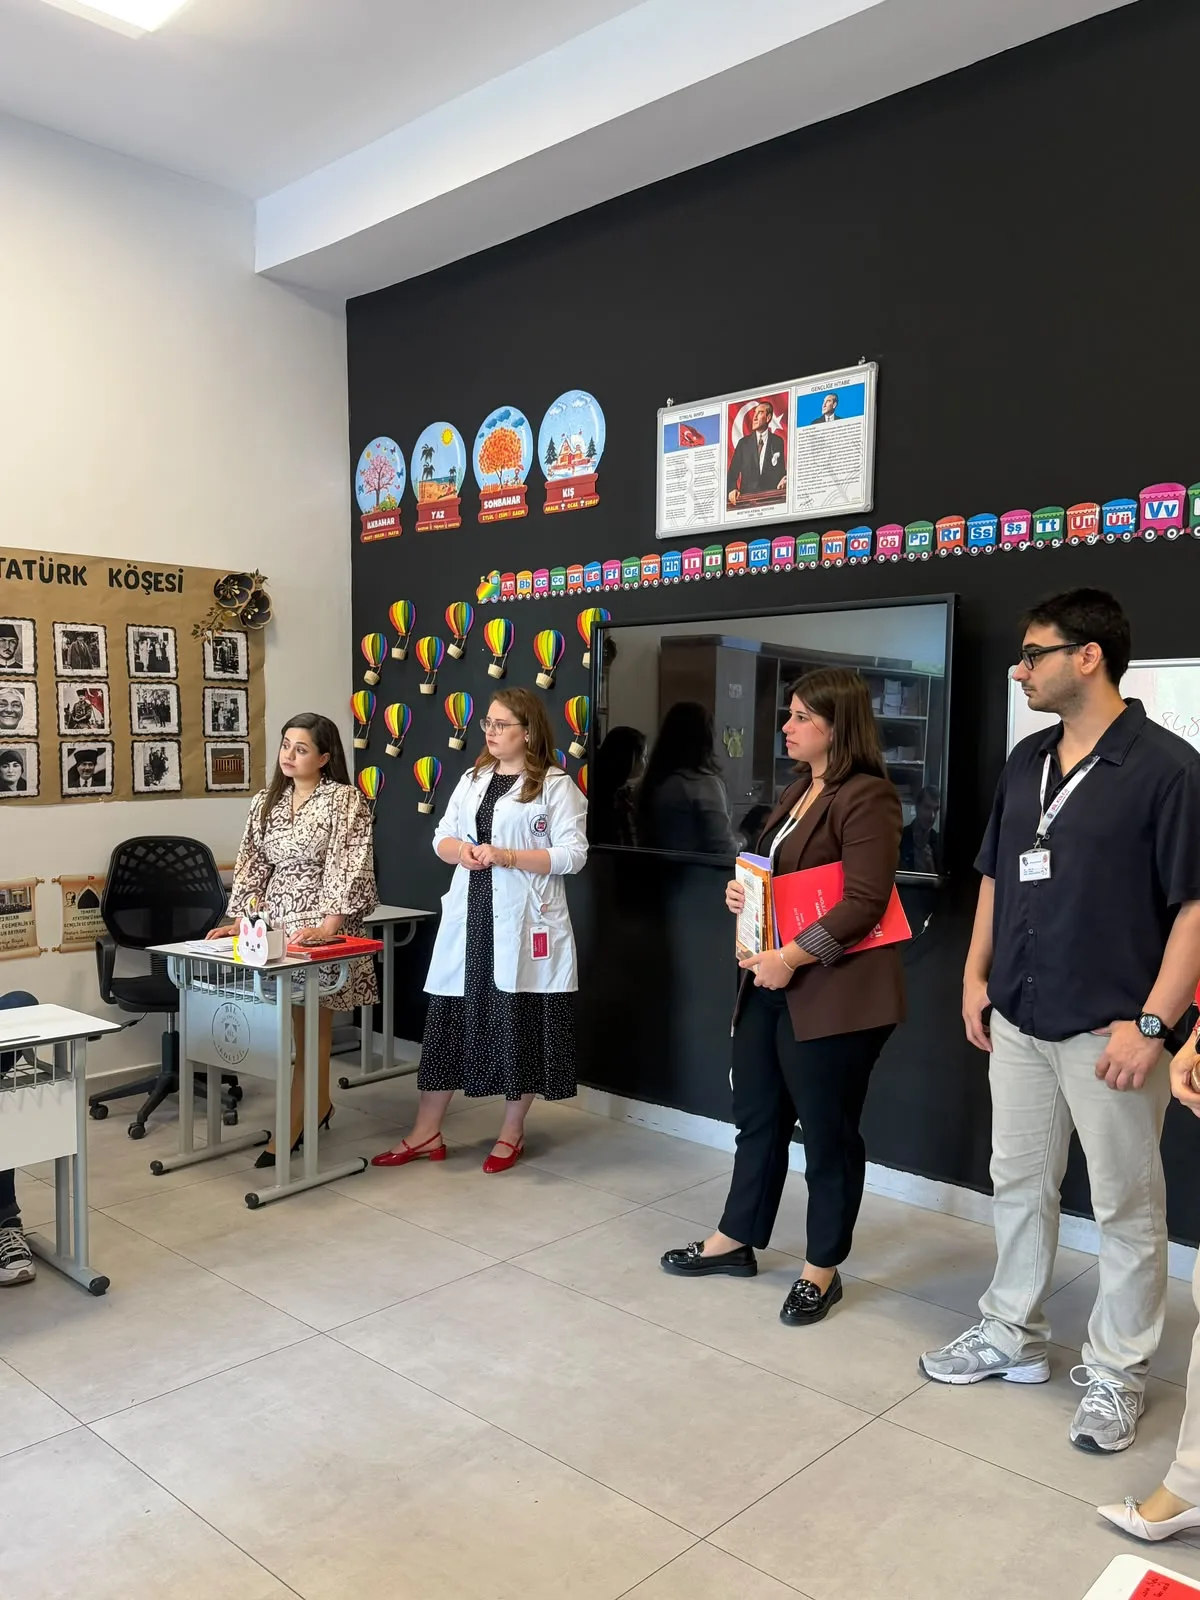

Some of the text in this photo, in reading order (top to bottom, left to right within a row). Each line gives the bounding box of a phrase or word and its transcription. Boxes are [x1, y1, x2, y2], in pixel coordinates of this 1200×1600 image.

[562, 487, 575, 499] KIŞ
[483, 496, 521, 509] SONBAHAR
[431, 510, 445, 519] YAZ
[503, 582, 513, 590] Aa
[519, 580, 530, 588] Bb
[535, 579, 546, 587] Cc
[552, 576, 563, 585] Çç
[569, 574, 581, 582] Dd
[587, 572, 599, 581] Ee
[605, 569, 617, 580] Ff
[624, 567, 638, 577] Gg
[664, 561, 678, 572] Hh
[752, 550, 767, 560] Kk
[776, 546, 790, 558] Ll
[799, 544, 817, 555] Mm
[825, 542, 842, 553] Nn
[850, 539, 869, 550] Oo
[880, 535, 897, 548] Öö
[909, 533, 928, 545] Pp
[941, 529, 959, 542] Rr
[972, 527, 991, 539] Ss
[1006, 522, 1022, 535] Şş
[1038, 519, 1057, 532] Tt
[1072, 516, 1094, 529] Uu
[1108, 512, 1130, 527] Üü
[1147, 501, 1178, 519] Vv
[109, 563, 184, 596] KÖŞESİ
[225, 1004, 236, 1014] BİL
